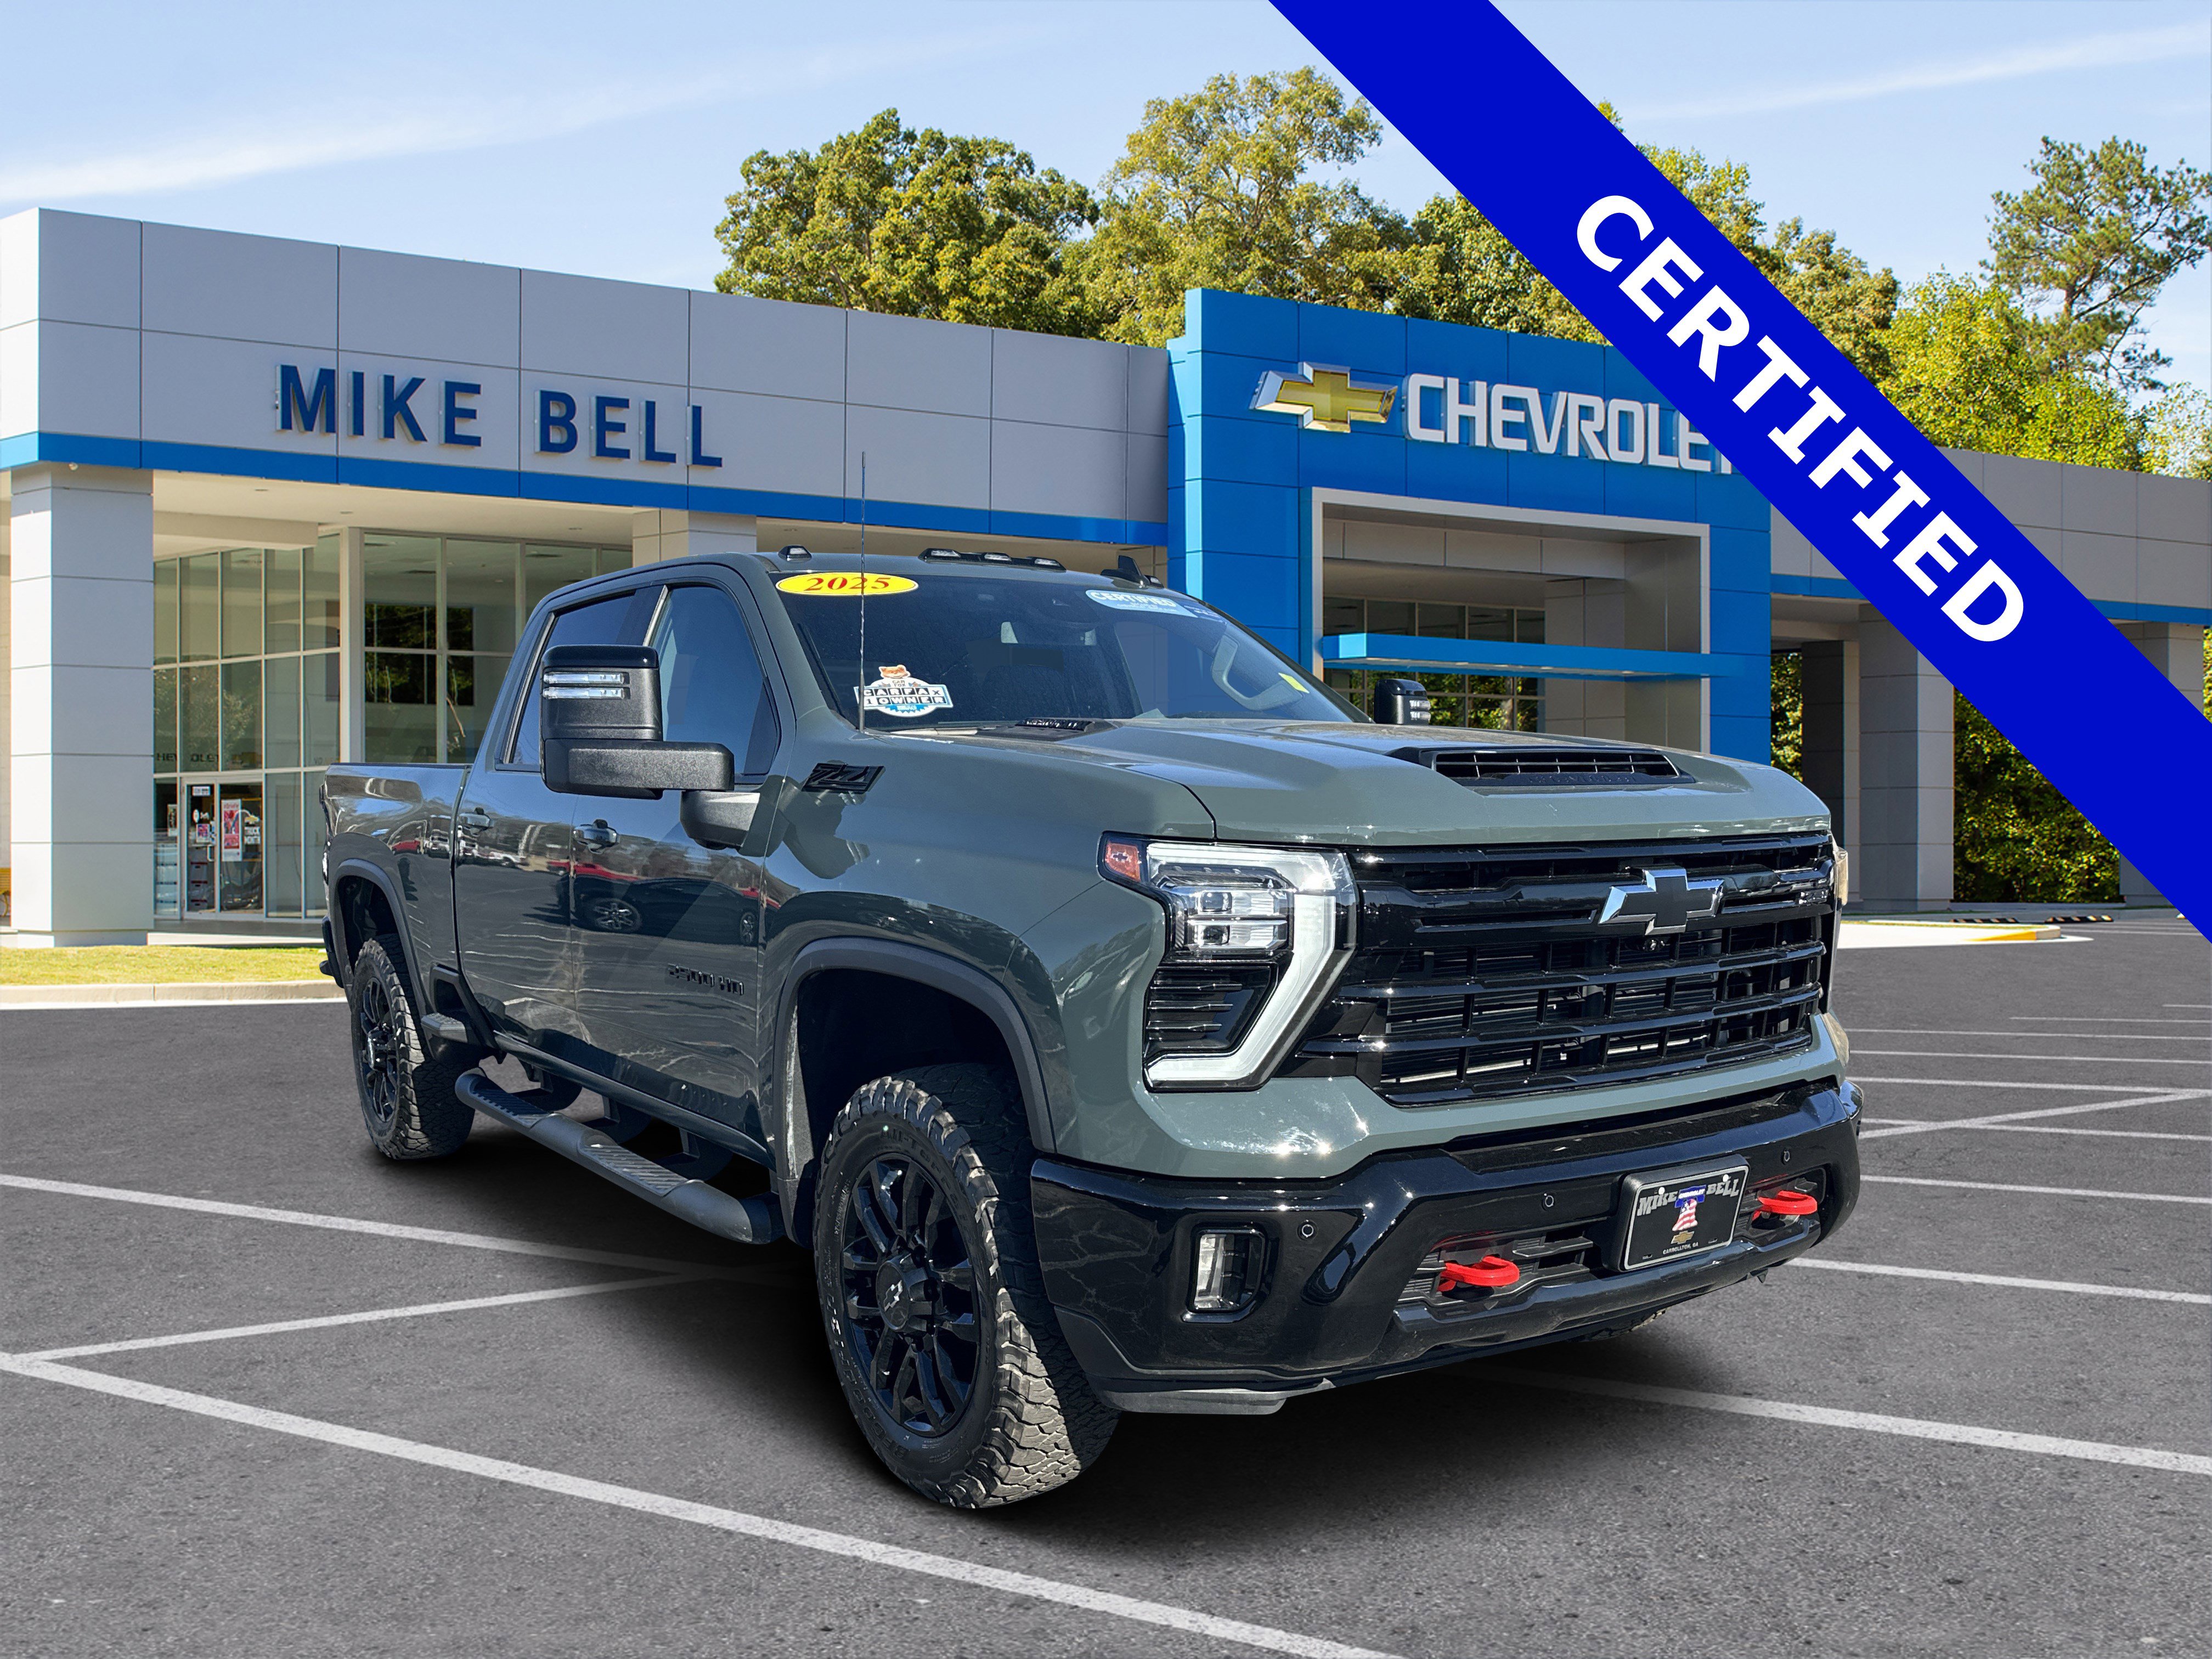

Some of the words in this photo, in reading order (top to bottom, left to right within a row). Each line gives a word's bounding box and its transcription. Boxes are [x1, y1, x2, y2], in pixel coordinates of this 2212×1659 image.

[276, 364, 482, 448] MIKE
[534, 390, 723, 468] BELL
[1402, 373, 1733, 475] CHEVROLE
[804, 577, 891, 591] 2025
[1090, 591, 1177, 607] CERTIFIED
[1637, 1190, 1679, 1216] MIKE
[1706, 1178, 1739, 1197] BELL
